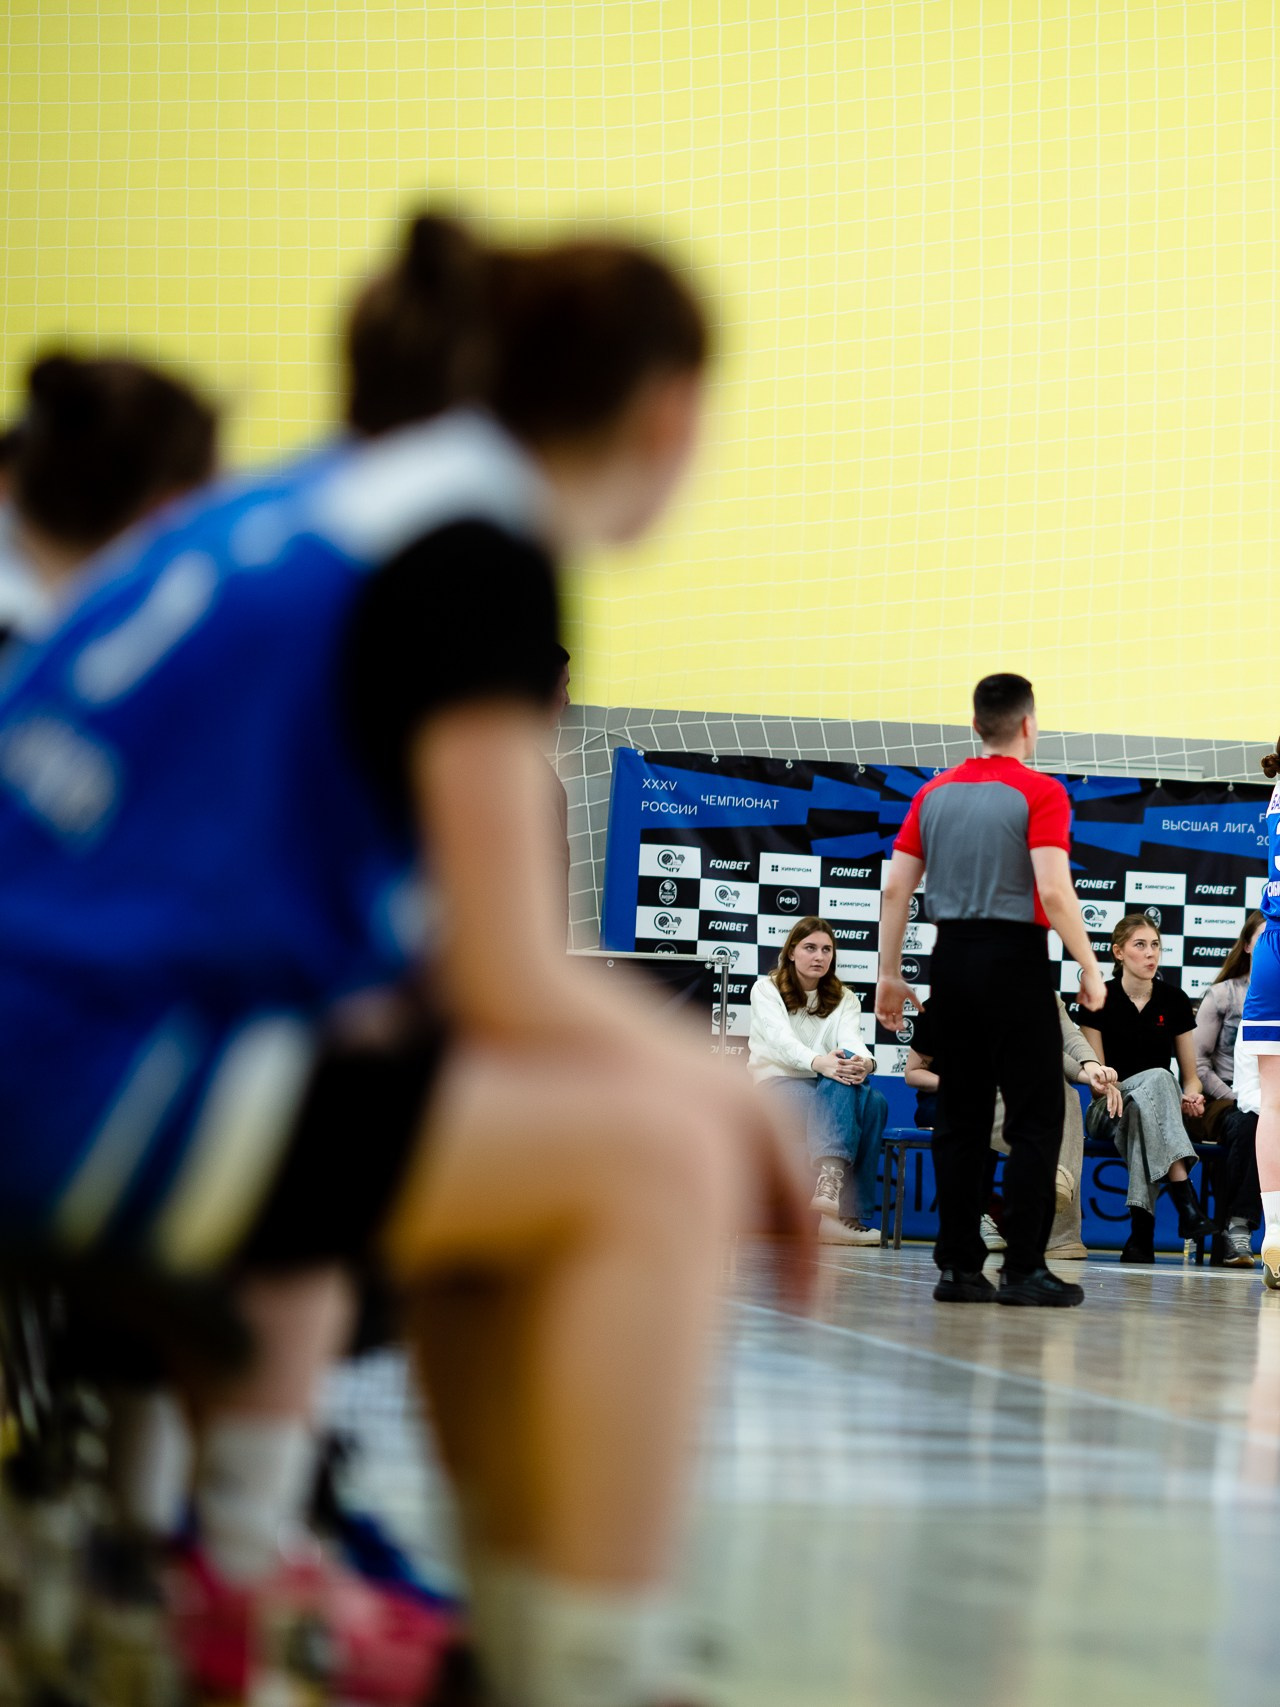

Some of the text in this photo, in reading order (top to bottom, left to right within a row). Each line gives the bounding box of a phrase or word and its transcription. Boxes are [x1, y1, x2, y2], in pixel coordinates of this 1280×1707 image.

[642, 778, 678, 791] XXXV
[700, 794, 780, 810] ЧЕМПИОНАТ
[641, 801, 698, 815] РОССИИ
[1161, 819, 1256, 834] ВЫСШАЯ ЛИГА
[709, 859, 751, 871] FONBET
[830, 867, 872, 878] FONBET
[1075, 879, 1117, 889] FONBET
[1195, 884, 1237, 895] FONBET
[779, 896, 798, 905] РФБ
[708, 921, 749, 932] FONBET
